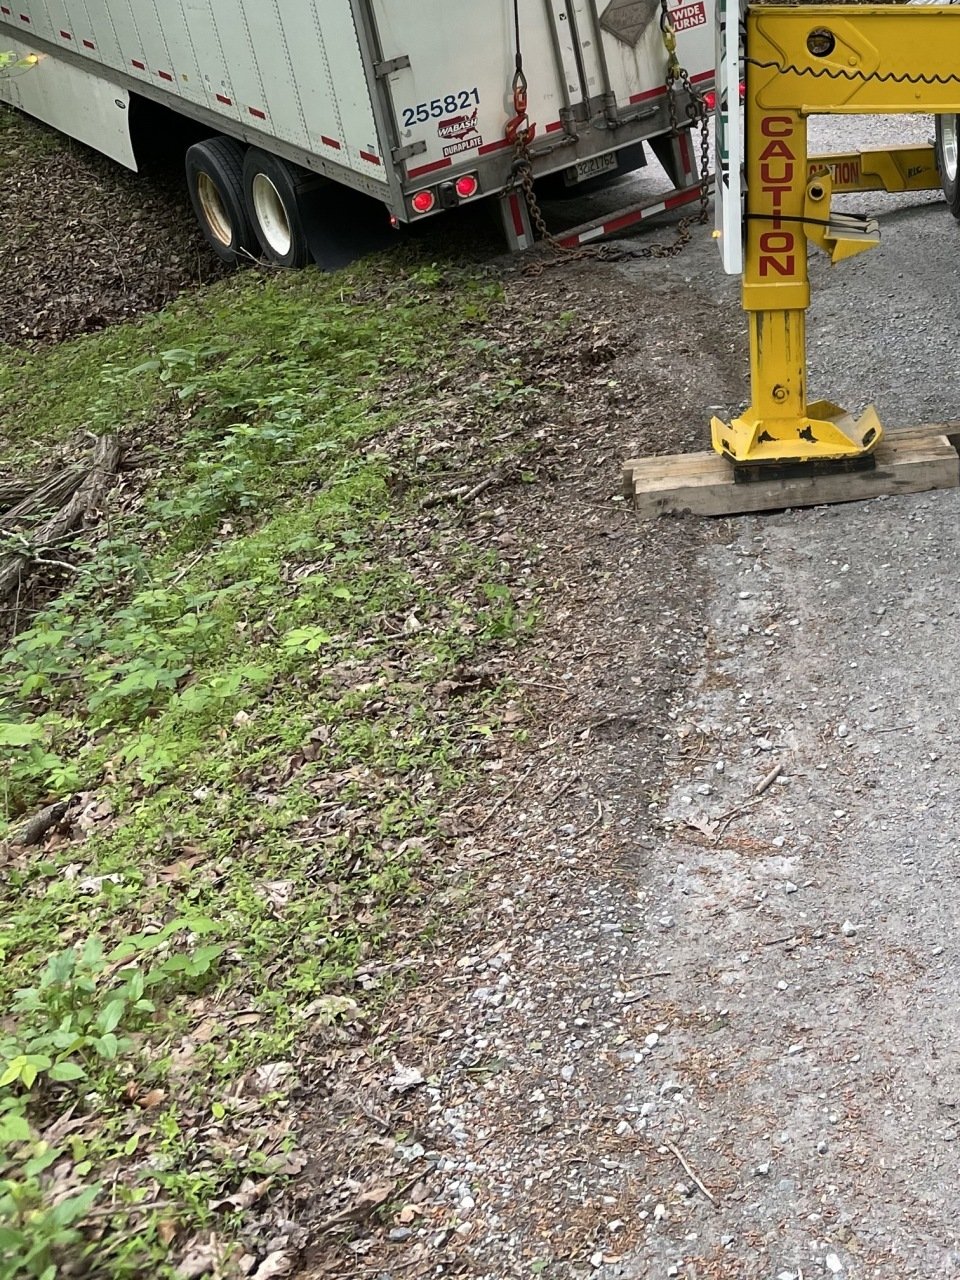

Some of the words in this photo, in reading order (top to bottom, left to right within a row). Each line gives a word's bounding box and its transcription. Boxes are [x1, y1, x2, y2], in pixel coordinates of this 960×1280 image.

[672, 4, 700, 20] WIDE
[402, 87, 480, 127] 255821
[438, 118, 478, 137] WABASH
[443, 136, 482, 157] DURAPLATE
[809, 161, 859, 185] CTION
[758, 116, 796, 277] CAUTION
